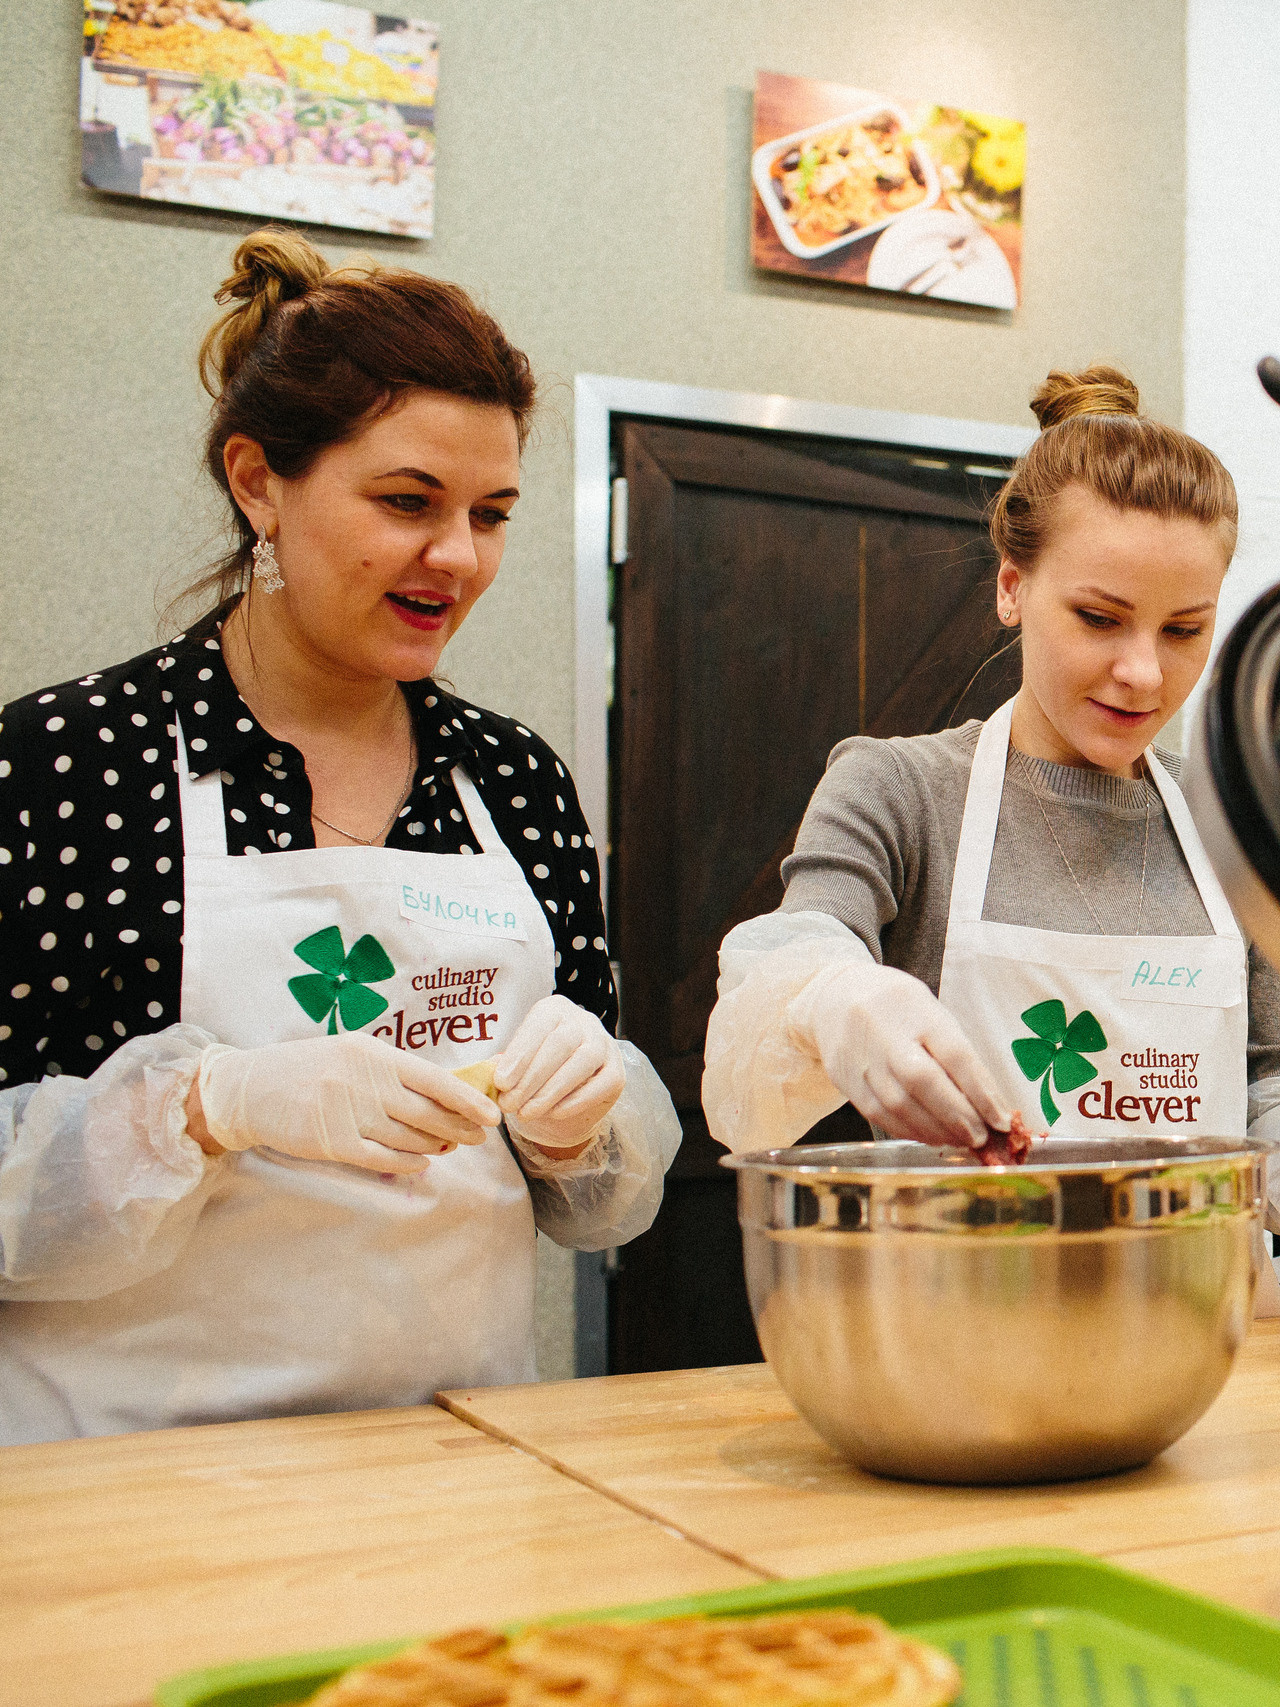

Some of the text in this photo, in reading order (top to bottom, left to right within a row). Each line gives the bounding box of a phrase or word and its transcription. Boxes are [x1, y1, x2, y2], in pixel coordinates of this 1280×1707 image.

[403, 886, 517, 929] БУЛОЧКА
[411, 967, 499, 991] culinary
[1131, 960, 1202, 988] ALEX
[428, 986, 495, 1011] studio
[1120, 1048, 1200, 1072] culinary
[1139, 1070, 1198, 1089] studio
[1077, 1081, 1201, 1124] clever
